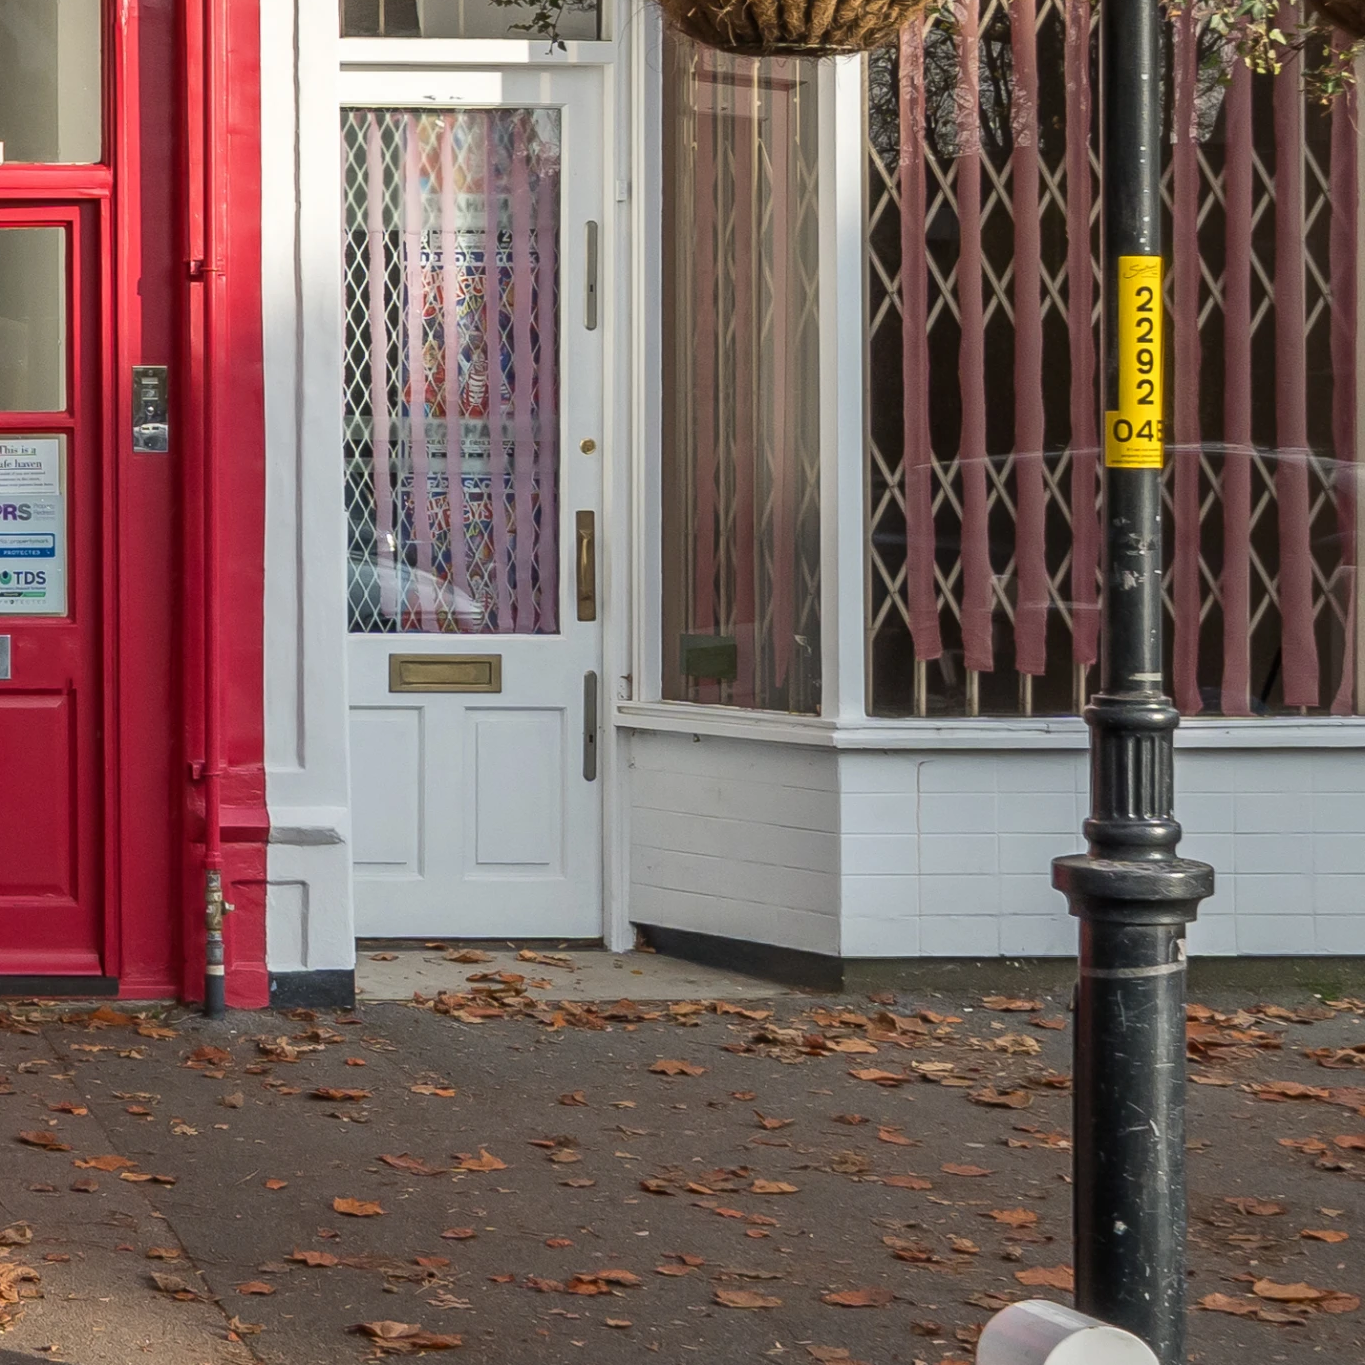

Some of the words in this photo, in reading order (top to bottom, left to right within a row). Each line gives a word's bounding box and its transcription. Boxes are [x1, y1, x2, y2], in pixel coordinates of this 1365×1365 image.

[21, 445, 29, 454] is
[30, 447, 37, 455] a
[14, 459, 42, 468] haven
[13, 570, 47, 585] TDS
